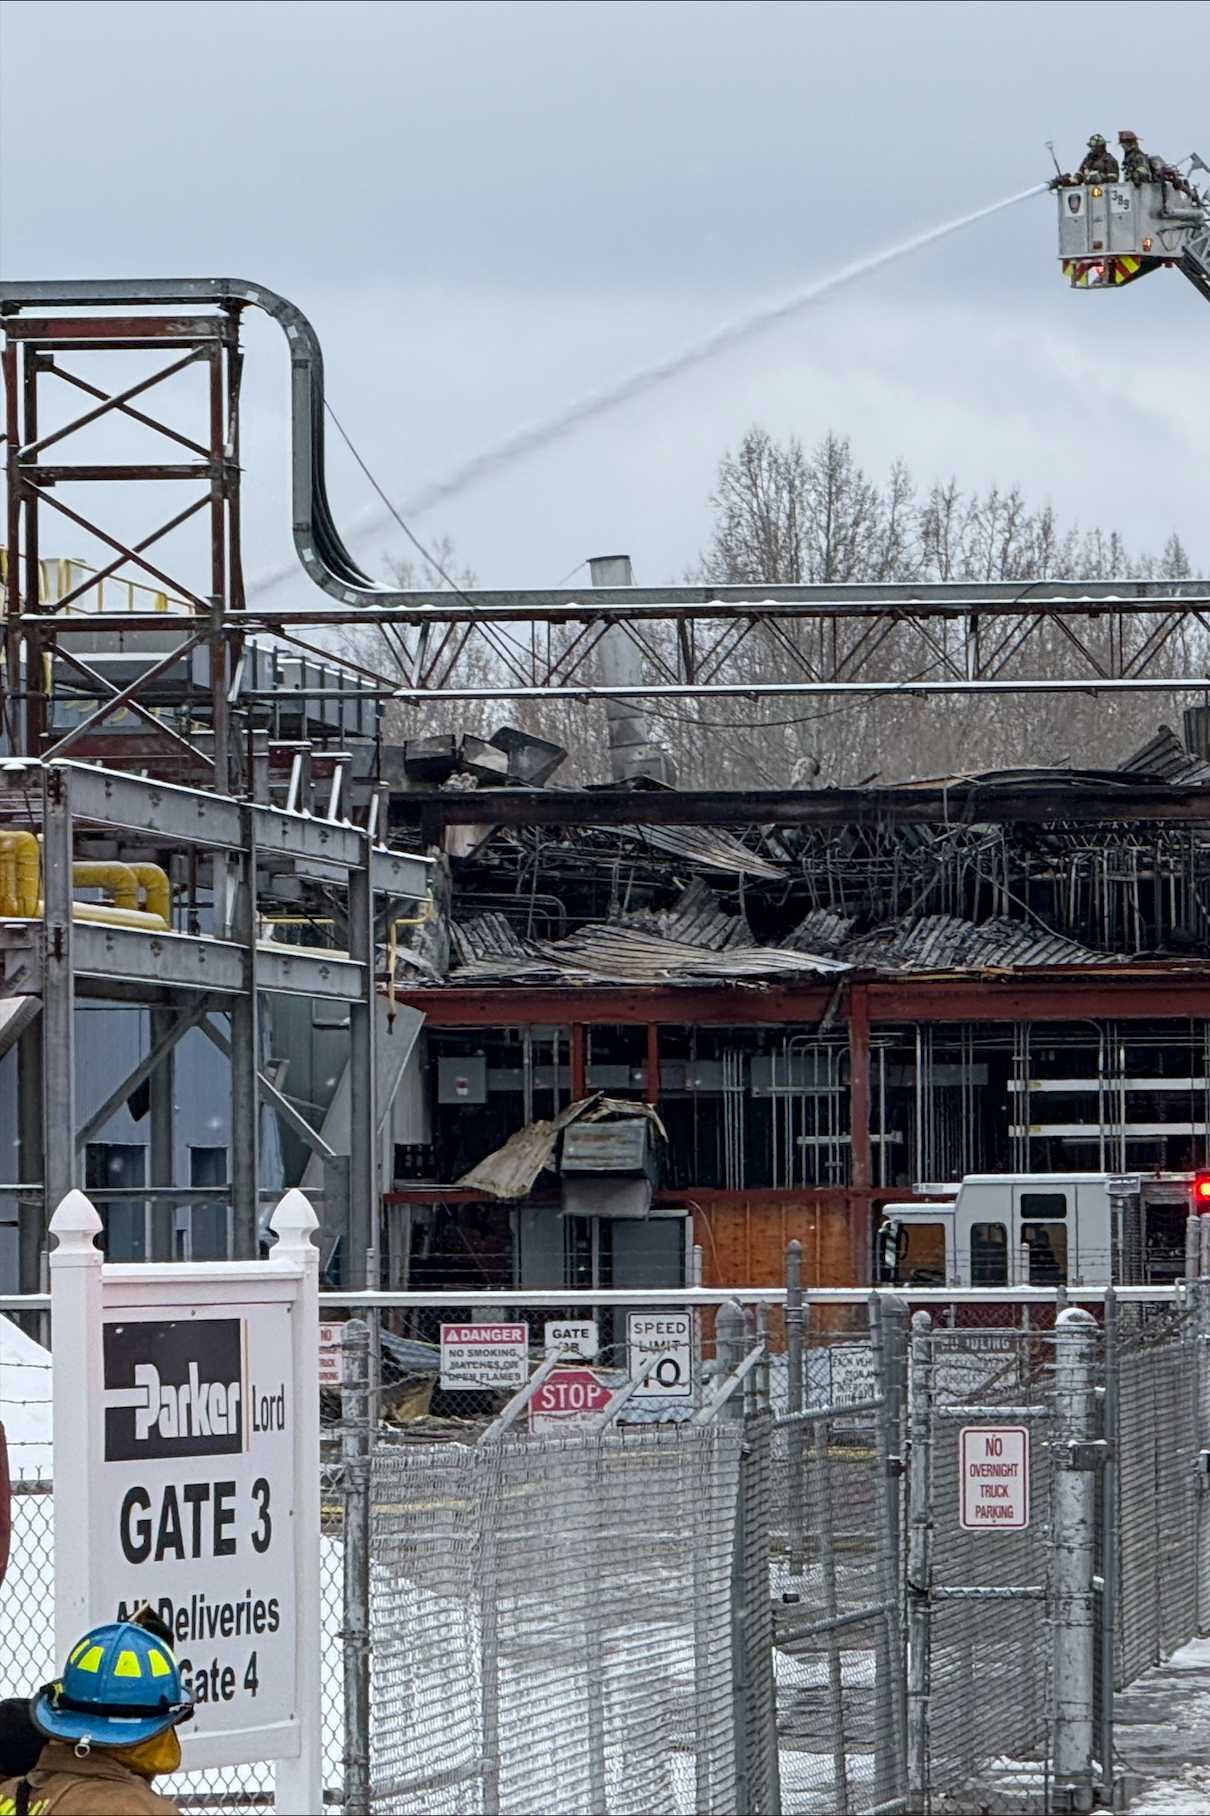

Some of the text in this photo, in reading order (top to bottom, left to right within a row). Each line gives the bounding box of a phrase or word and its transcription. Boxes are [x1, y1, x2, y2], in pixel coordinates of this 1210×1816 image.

[460, 1328, 522, 1342] DANGER
[552, 1328, 590, 1339] GATE
[634, 1322, 687, 1334] SPEED
[448, 1348, 465, 1358] NO
[467, 1348, 518, 1358] SMOKING
[639, 1340, 681, 1352] LIMIT
[480, 1373, 520, 1381] FLAMES
[135, 1362, 286, 1440] Parker Lord
[541, 1384, 600, 1409] STOP
[985, 1438, 1003, 1457] NO
[969, 1463, 1019, 1478] OVERNIGHT
[980, 1484, 1009, 1498] TRUCK
[975, 1505, 1014, 1519] PARKING
[120, 1477, 272, 1565] GATE 3
[158, 1589, 280, 1642] Deliveries
[178, 1651, 259, 1704] Gate 4
